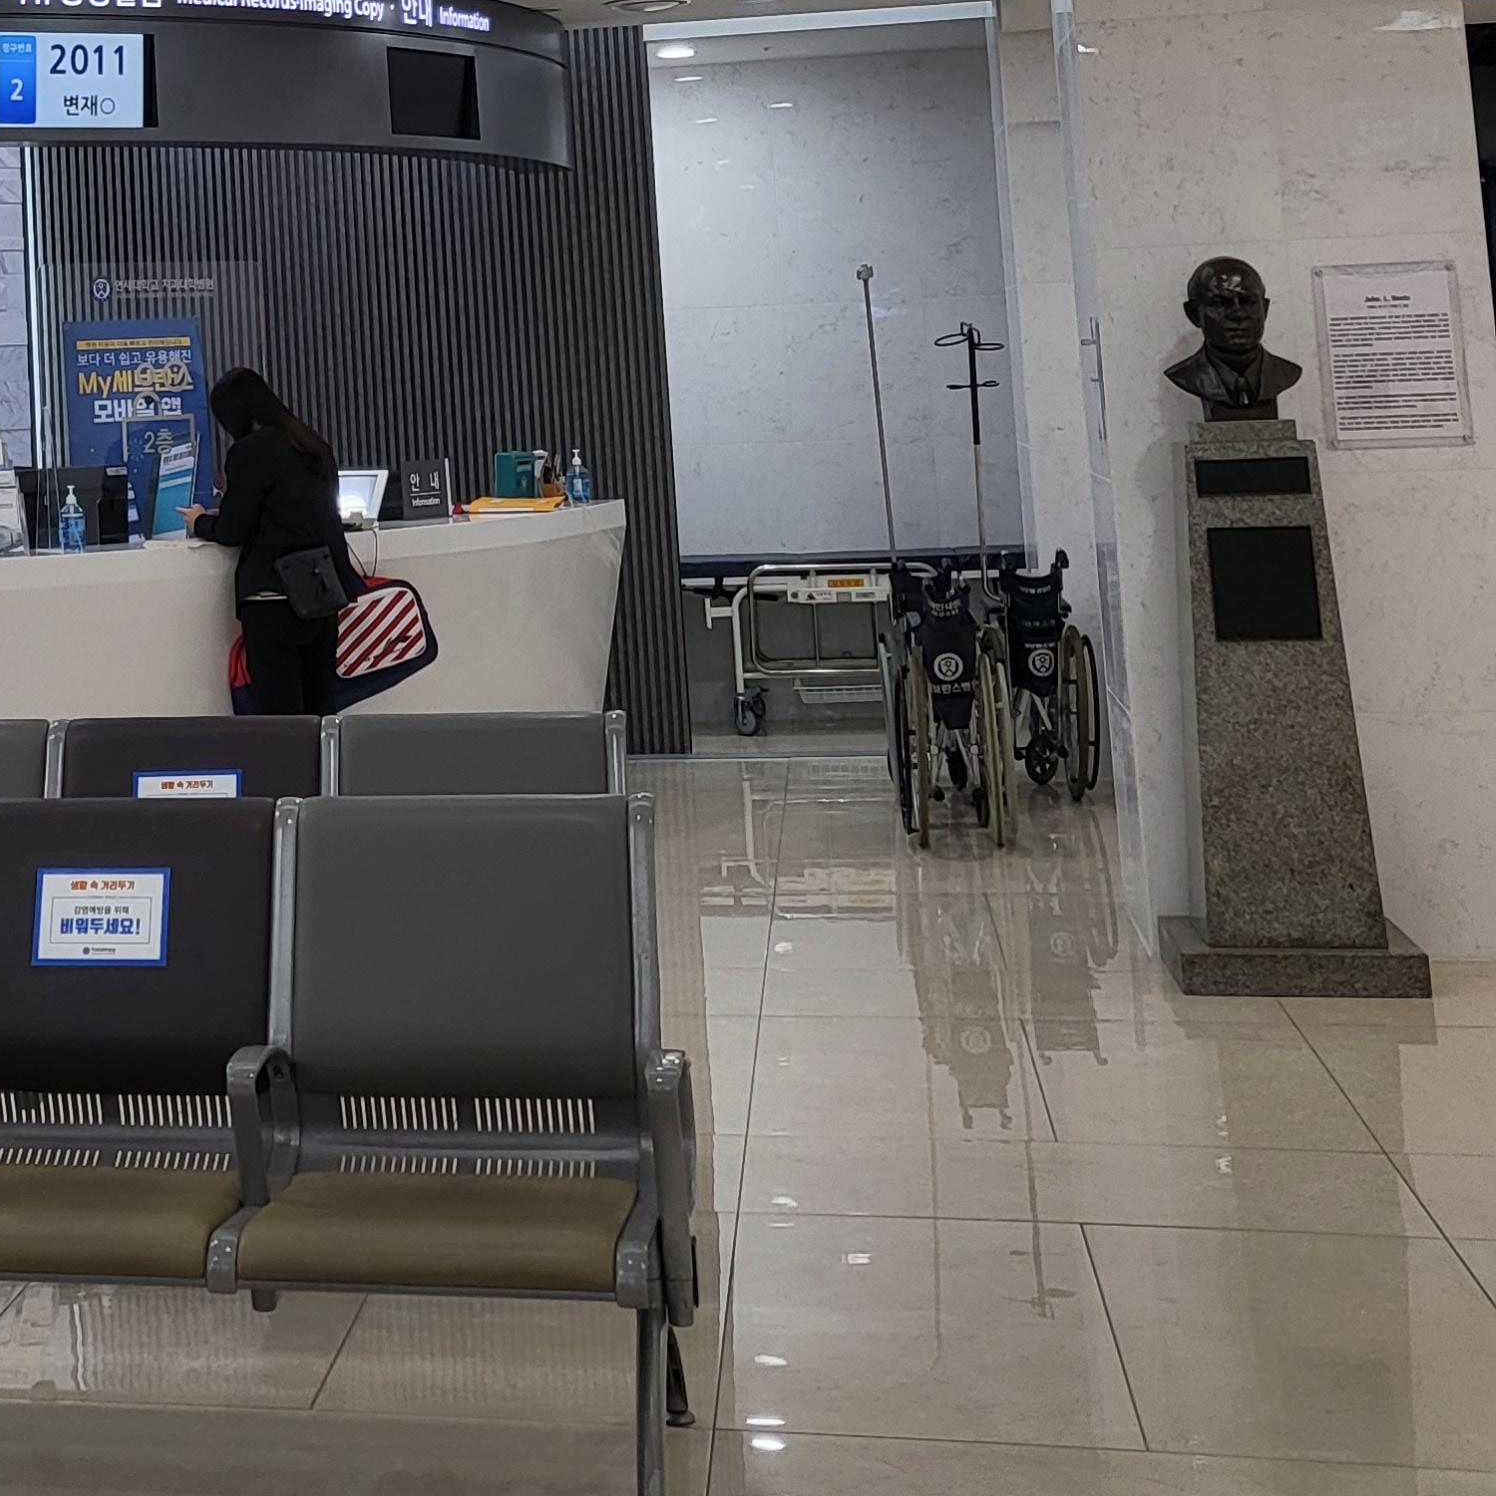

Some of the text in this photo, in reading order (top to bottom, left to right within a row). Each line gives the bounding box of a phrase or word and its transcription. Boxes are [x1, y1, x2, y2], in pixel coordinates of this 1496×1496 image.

[439, 6, 490, 32] Information
[49, 44, 124, 75] 2011
[10, 78, 24, 101] 2
[77, 353, 100, 366] 보다
[104, 352, 115, 366] 더
[119, 351, 142, 365] 쉽고
[101, 879, 135, 891] 거리두기
[60, 917, 141, 935] 비워두세요!
